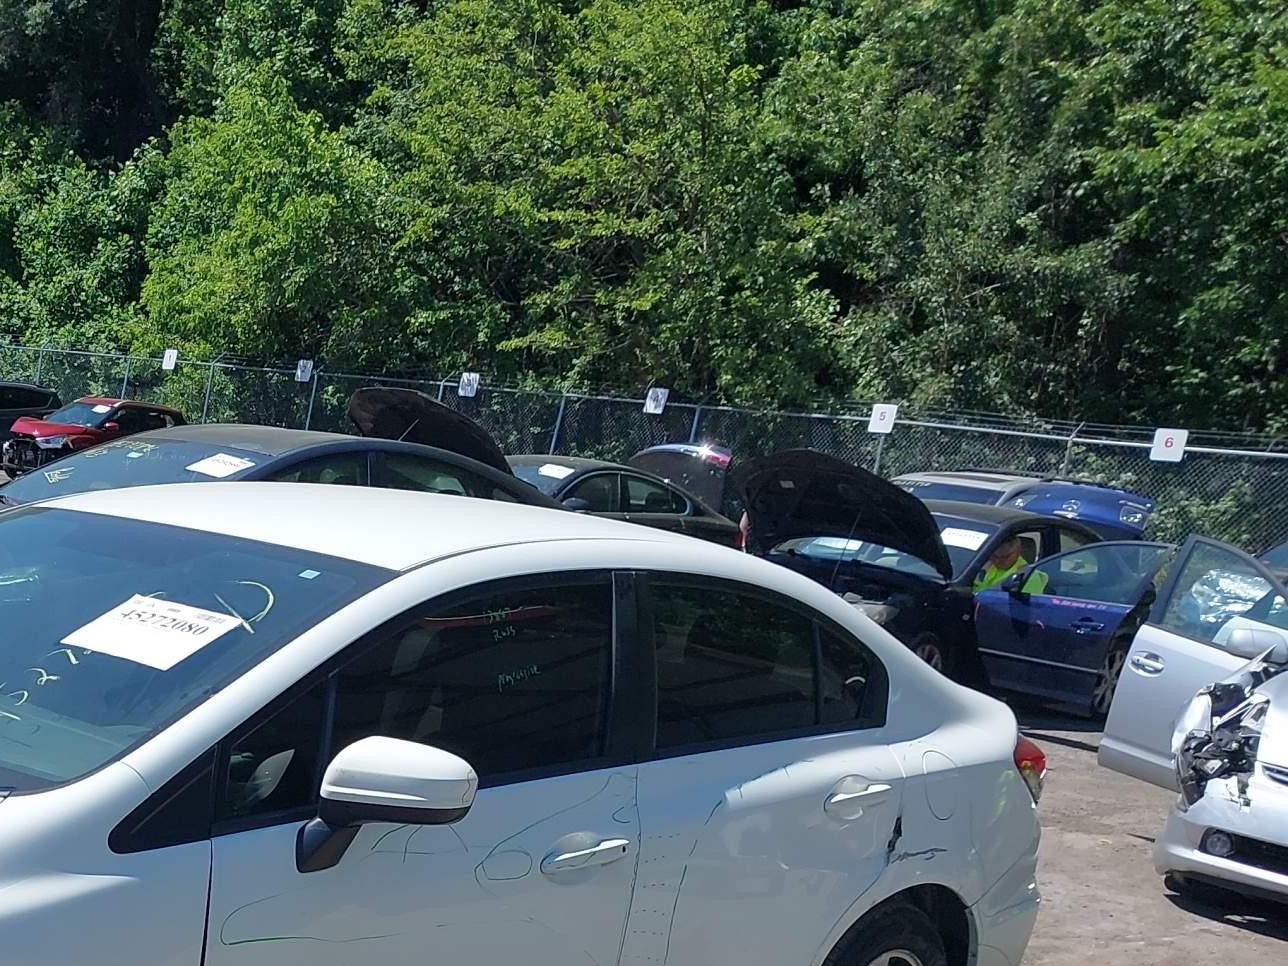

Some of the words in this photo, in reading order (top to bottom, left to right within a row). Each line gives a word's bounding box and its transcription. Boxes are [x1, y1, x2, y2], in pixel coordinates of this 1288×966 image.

[879, 411, 887, 421] 5
[1164, 437, 1174, 448] 6
[121, 609, 209, 635] 45272080
